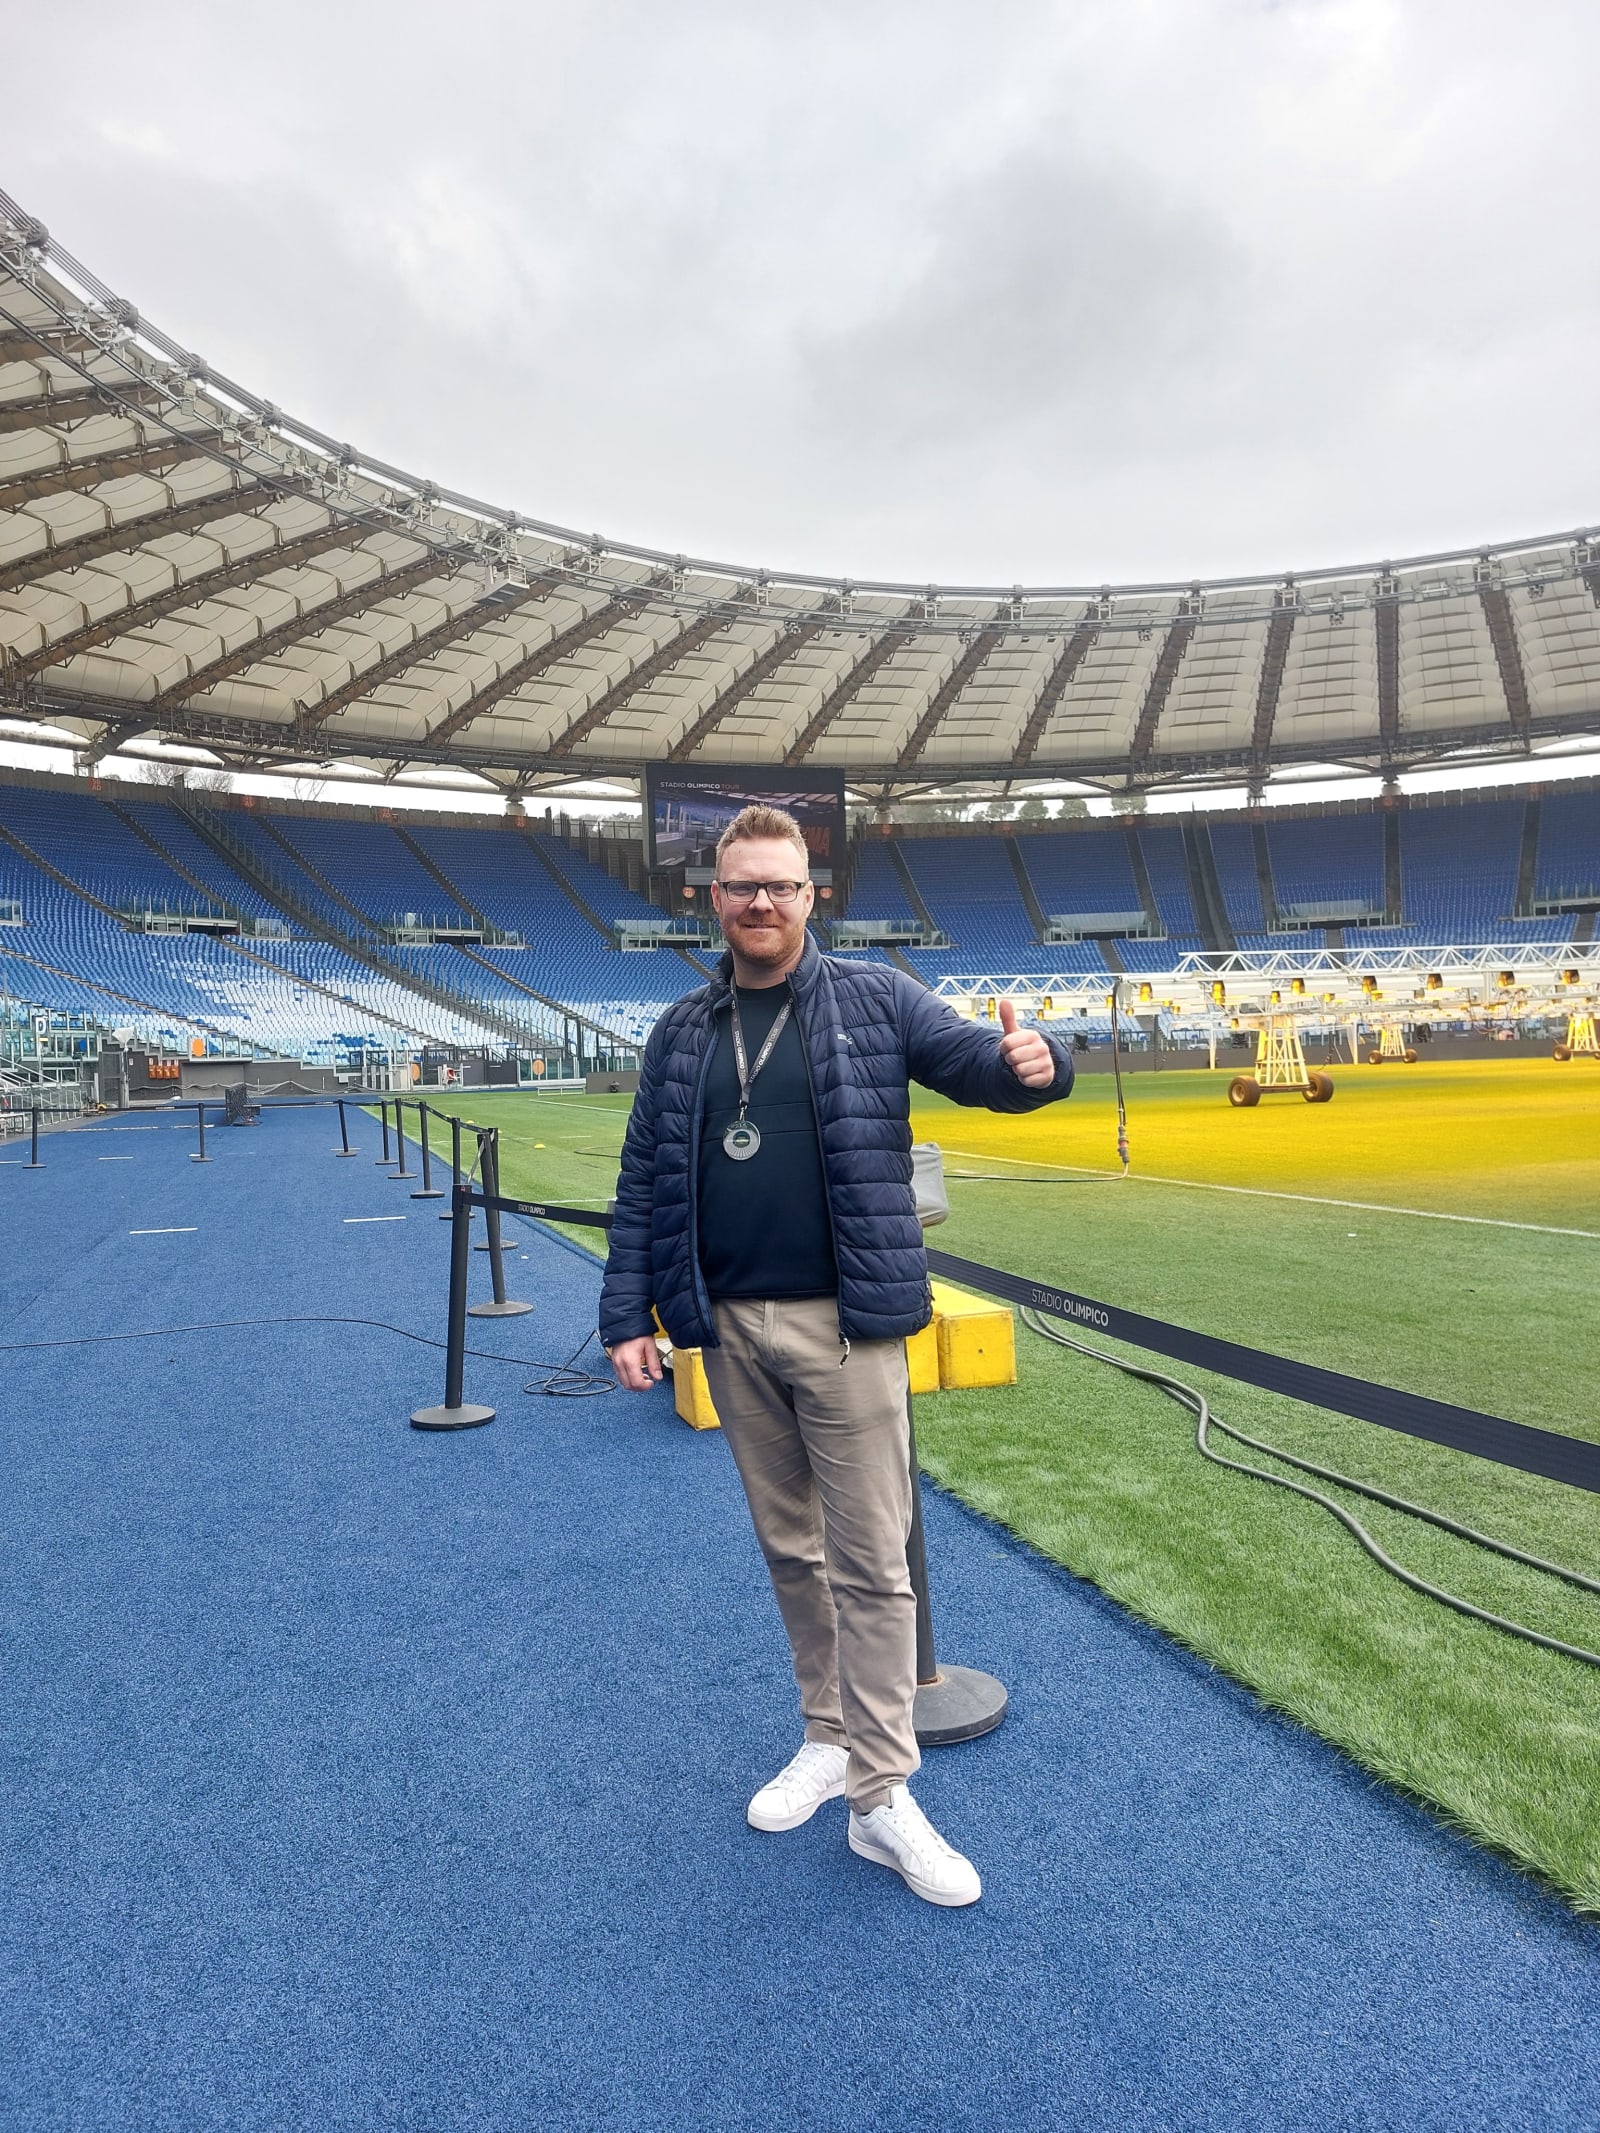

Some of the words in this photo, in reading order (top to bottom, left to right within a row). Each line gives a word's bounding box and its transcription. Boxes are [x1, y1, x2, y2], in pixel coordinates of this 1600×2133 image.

[35, 1016, 47, 1035] D
[749, 1065, 761, 1084] STADIO
[758, 1042, 773, 1066] OLIMPICO
[769, 1028, 780, 1042] TOUR
[1032, 1289, 1062, 1310] STADIO
[1063, 1299, 1109, 1327] OLIMPICO
